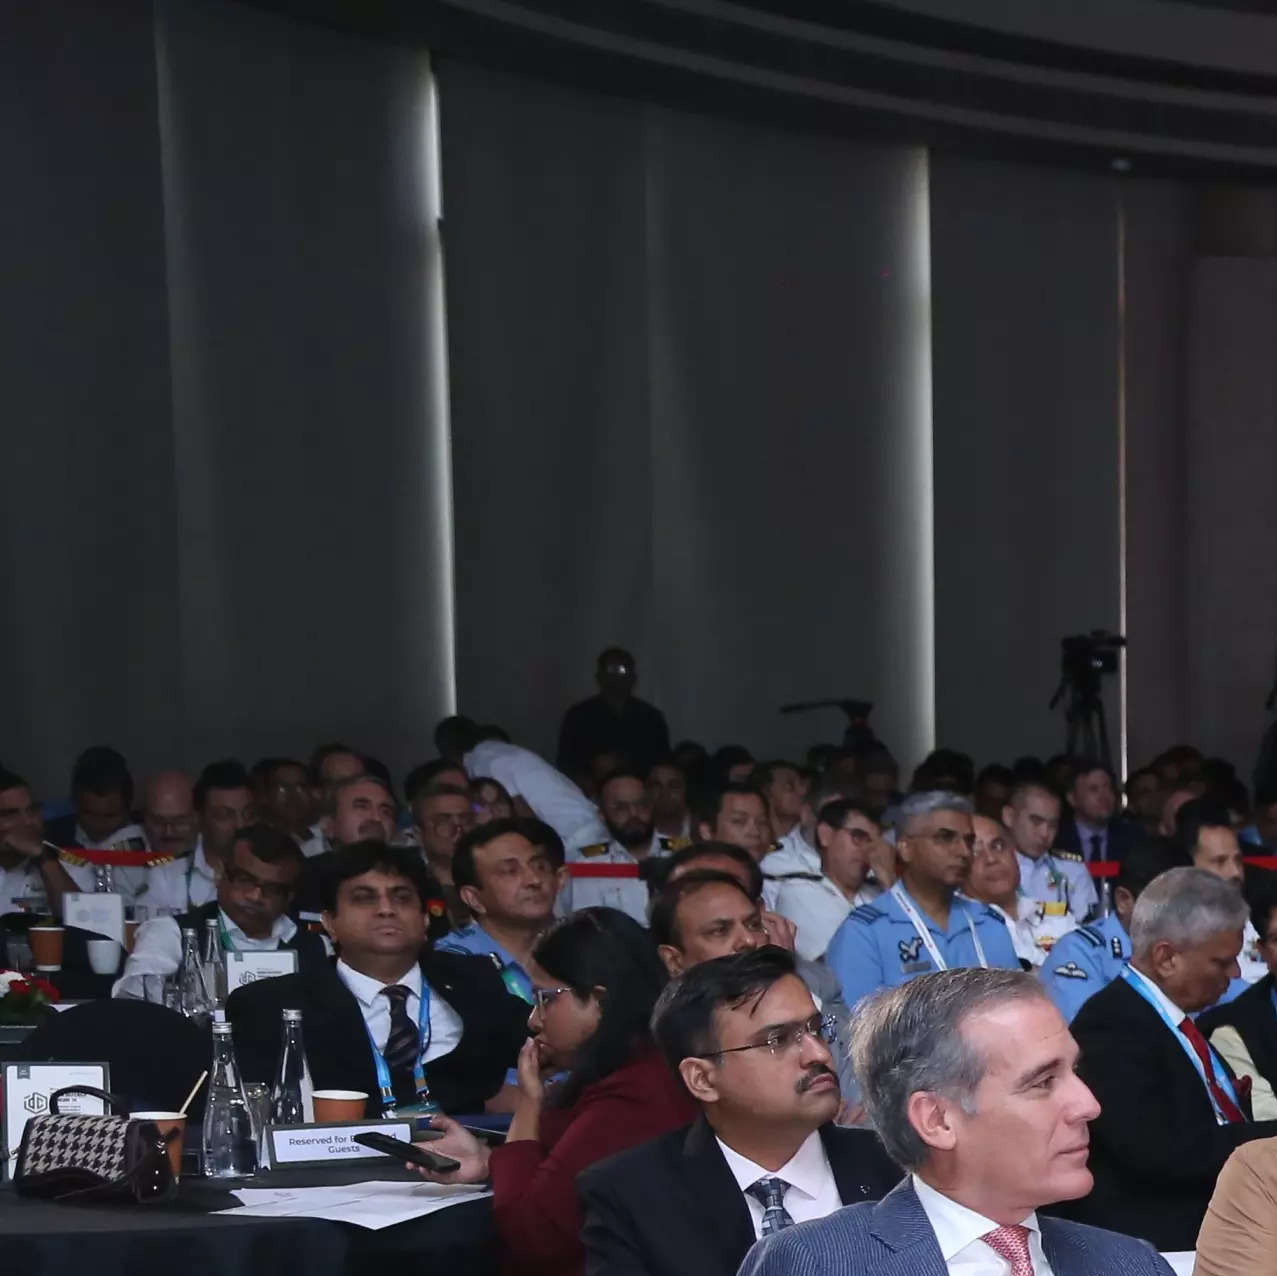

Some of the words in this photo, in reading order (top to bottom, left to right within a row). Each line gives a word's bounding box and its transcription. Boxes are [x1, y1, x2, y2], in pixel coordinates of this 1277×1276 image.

[288, 1136, 332, 1146] Reserved
[334, 1135, 347, 1145] for
[328, 1145, 360, 1154] Guests
